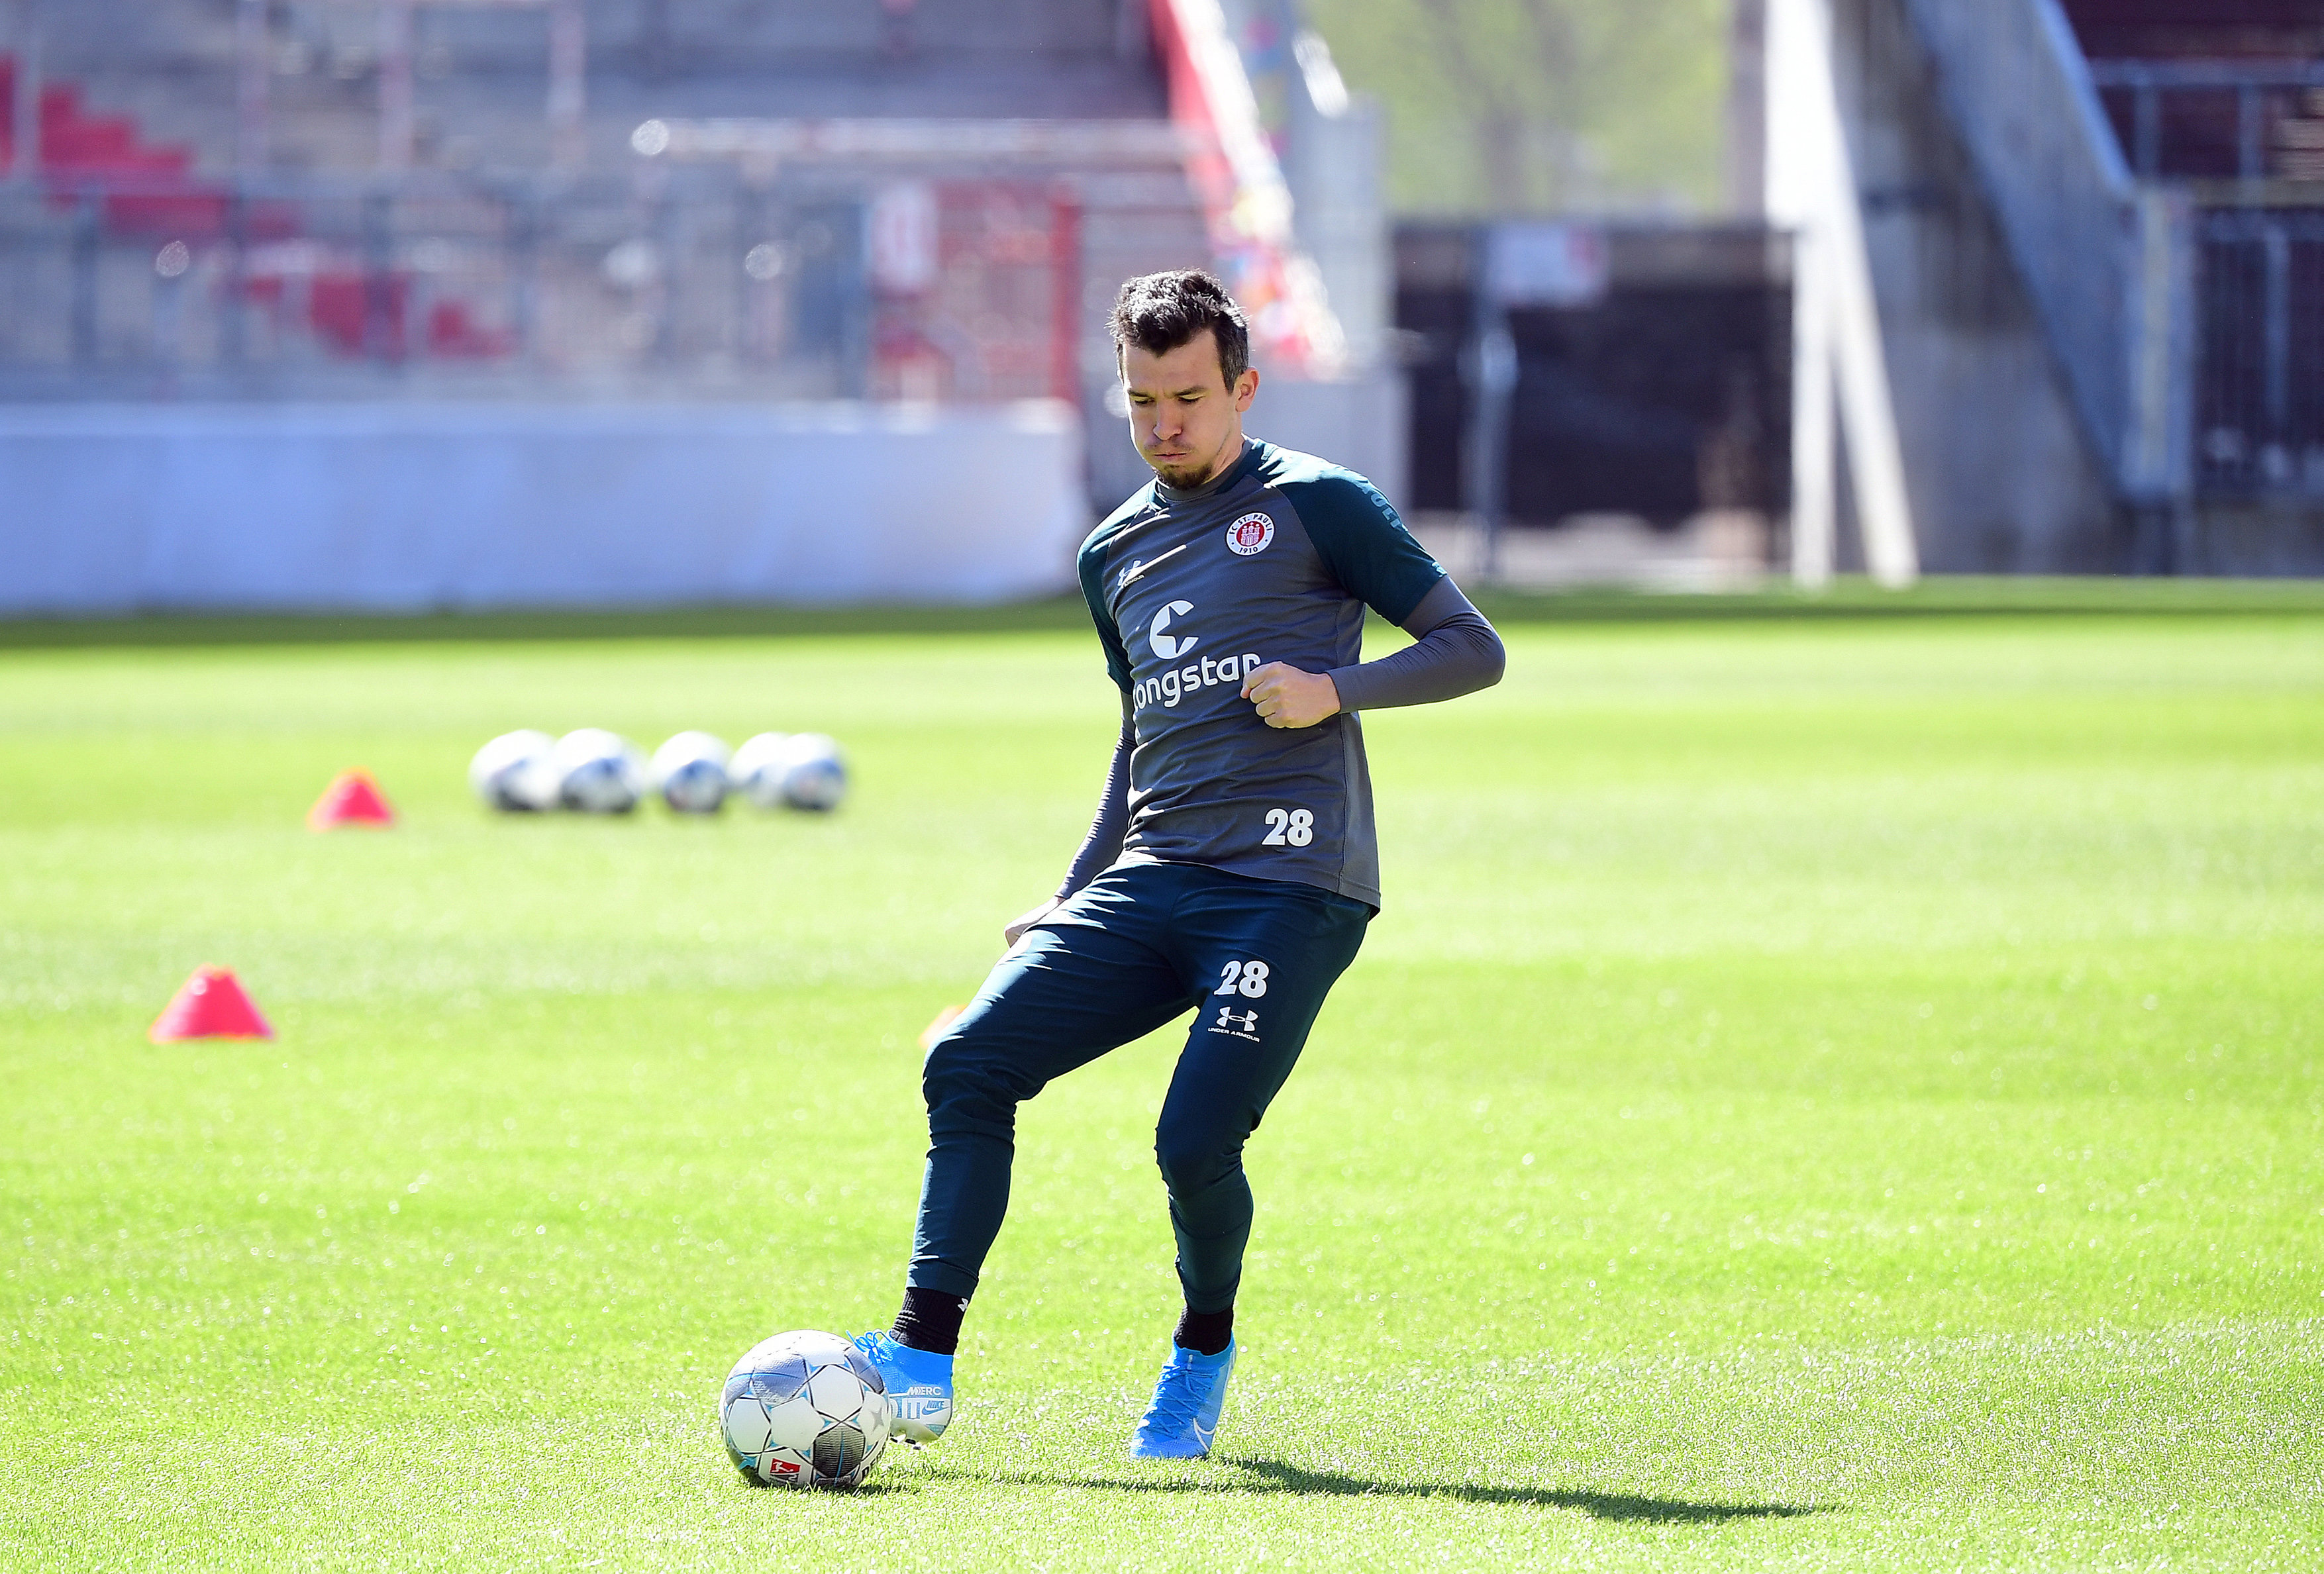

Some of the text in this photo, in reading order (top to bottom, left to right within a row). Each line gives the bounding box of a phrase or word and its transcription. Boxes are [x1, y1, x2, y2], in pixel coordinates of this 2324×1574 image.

[1229, 526, 1238, 534] FC
[1253, 514, 1272, 531] PAULI
[1133, 653, 1261, 713] ongstar
[1261, 808, 1314, 847] 28
[1213, 960, 1270, 999] 28
[1231, 1030, 1260, 1043] ARMOUR
[927, 1400, 945, 1408] NIKE
